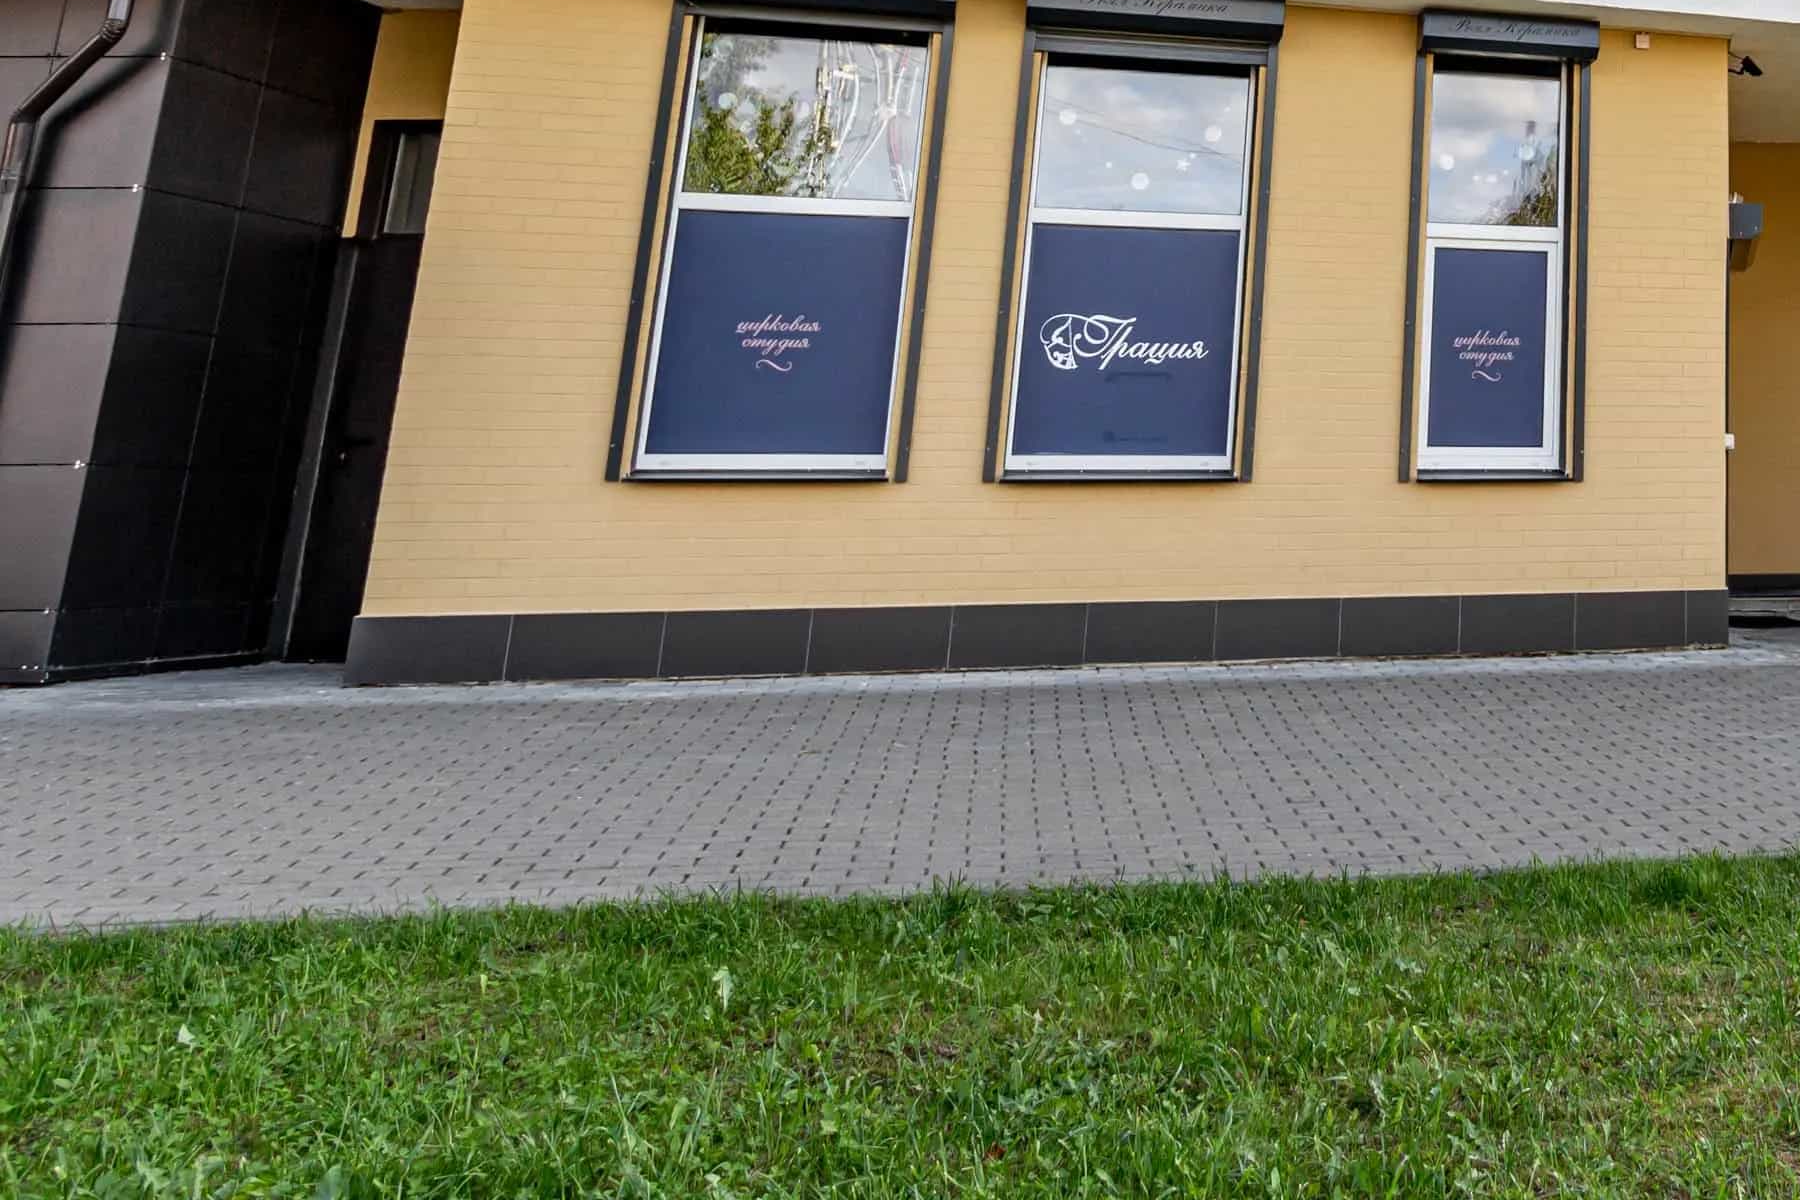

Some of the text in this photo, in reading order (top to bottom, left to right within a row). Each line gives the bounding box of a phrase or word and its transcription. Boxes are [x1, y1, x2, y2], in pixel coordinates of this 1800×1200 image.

[735, 313, 822, 337] цирковая
[741, 337, 811, 356] студия
[1073, 314, 1209, 370] Грация
[1453, 329, 1521, 350] цирковая
[1459, 350, 1515, 368] студия
